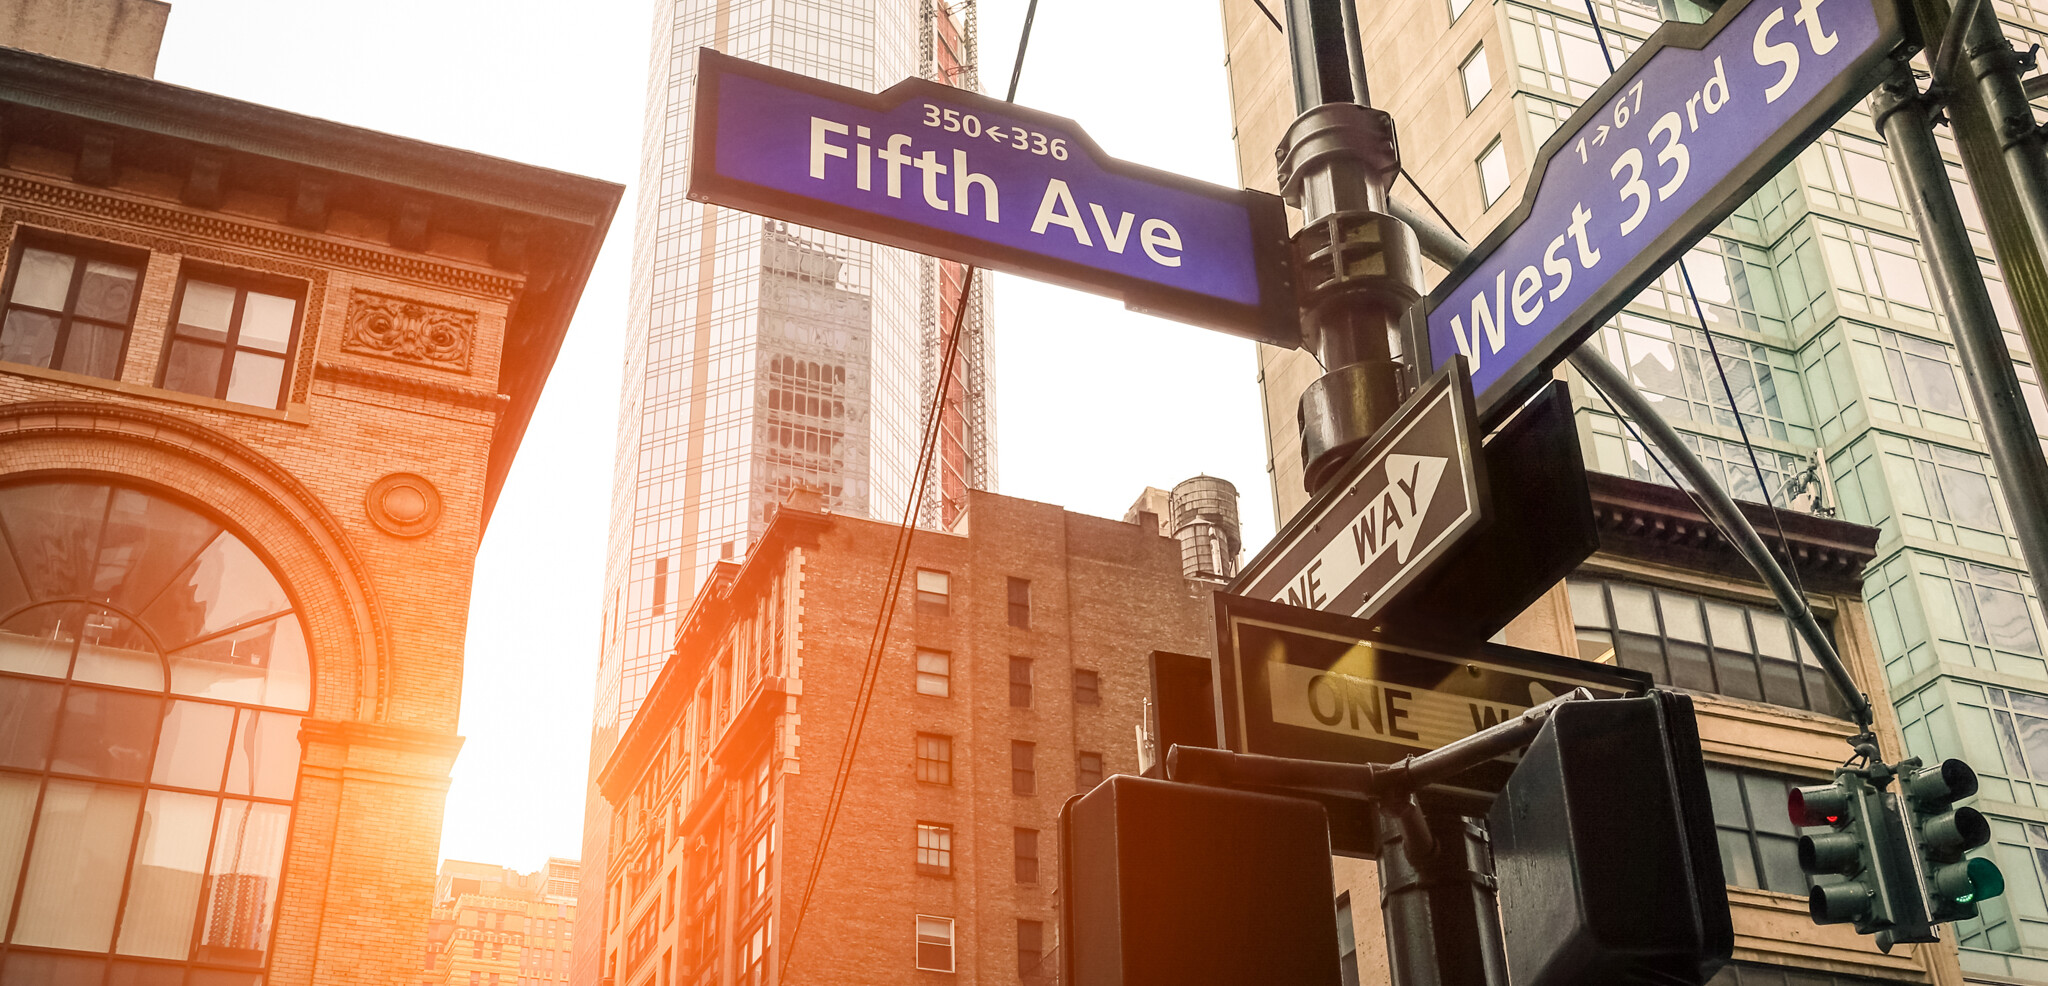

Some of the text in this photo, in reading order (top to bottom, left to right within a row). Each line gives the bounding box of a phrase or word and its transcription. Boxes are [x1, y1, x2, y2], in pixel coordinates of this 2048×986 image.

[922, 103, 1069, 162] 350 336
[1574, 79, 1644, 165] 1 67
[809, 115, 1184, 268] Fifth Ave
[1449, 0, 1840, 377] West 33rd St
[1275, 460, 1422, 610] NE WAY
[1308, 673, 1420, 741] ONE
